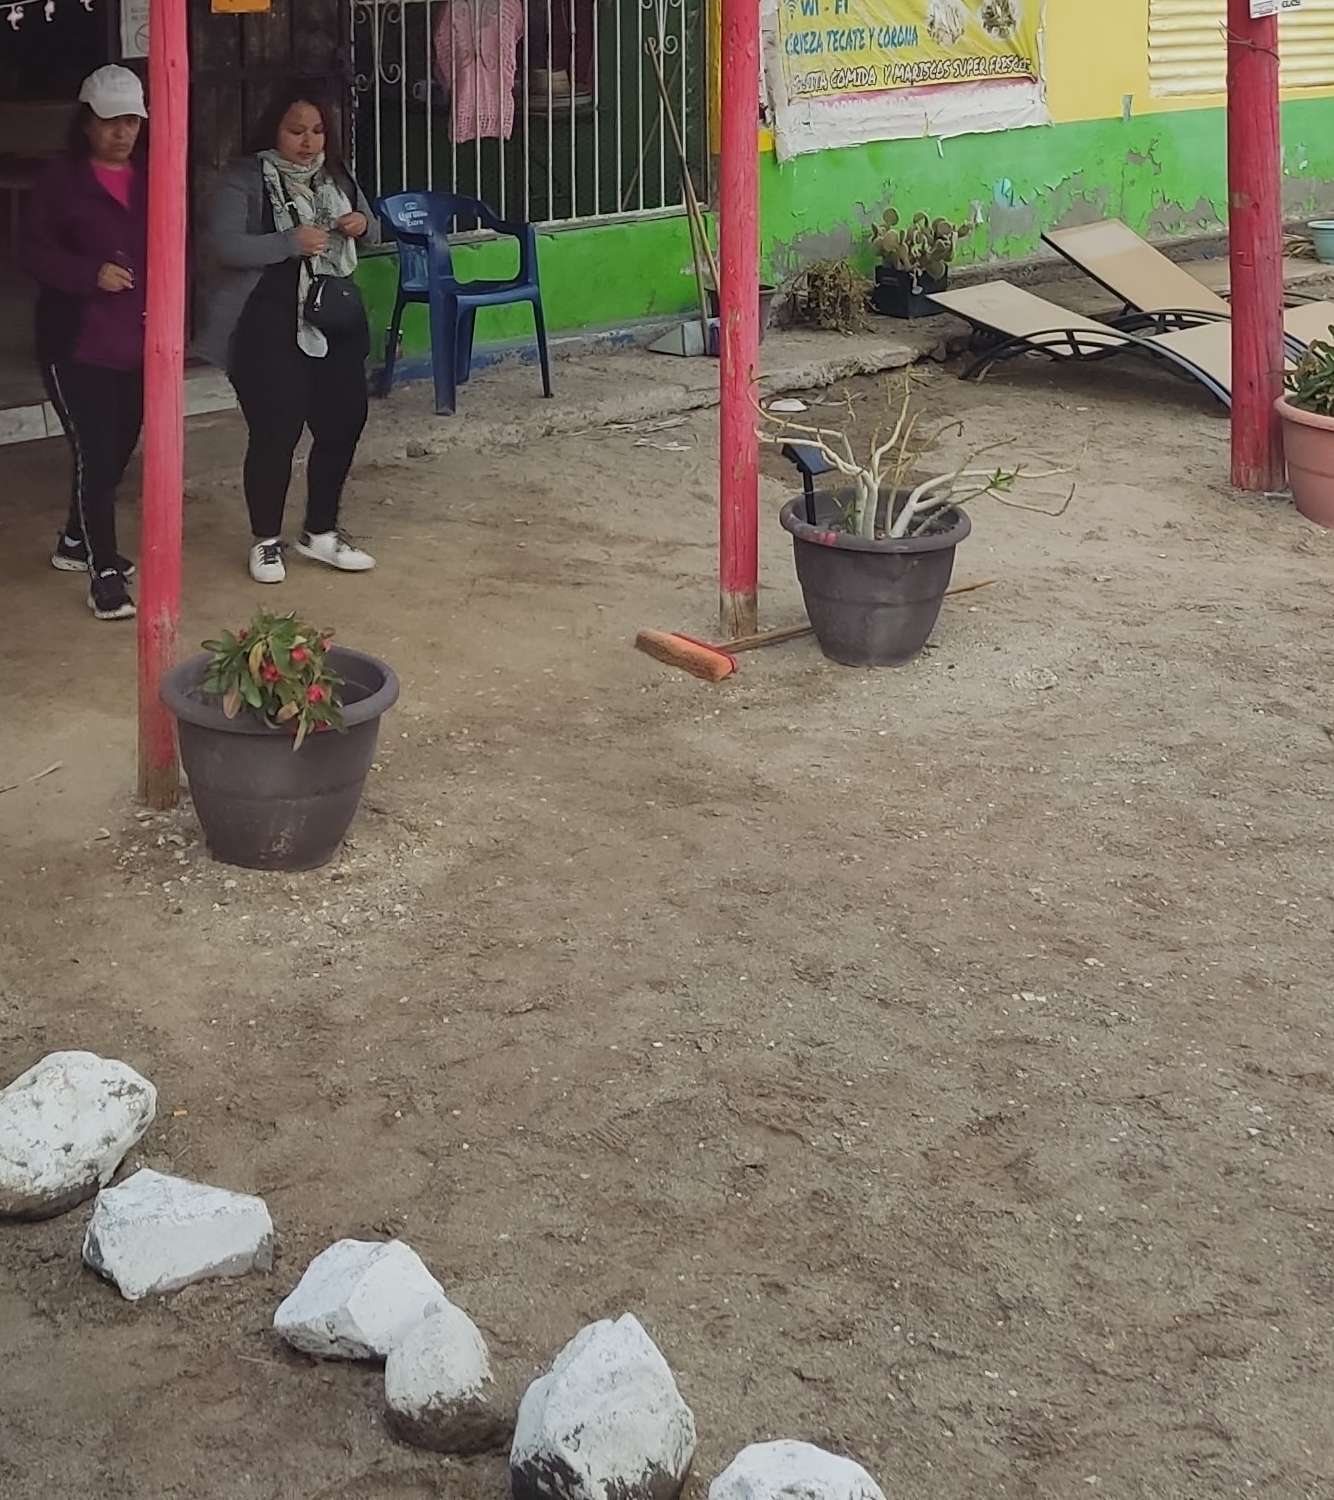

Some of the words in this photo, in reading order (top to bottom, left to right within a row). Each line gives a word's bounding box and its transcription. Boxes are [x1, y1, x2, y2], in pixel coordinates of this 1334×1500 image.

[826, 27, 866, 52] TECATE
[868, 26, 876, 50] Y
[877, 25, 919, 49] CORONA
[830, 66, 878, 90] COMIDA
[883, 63, 893, 85] Y
[892, 59, 953, 84] MARISCOS
[952, 55, 988, 79] SUPER
